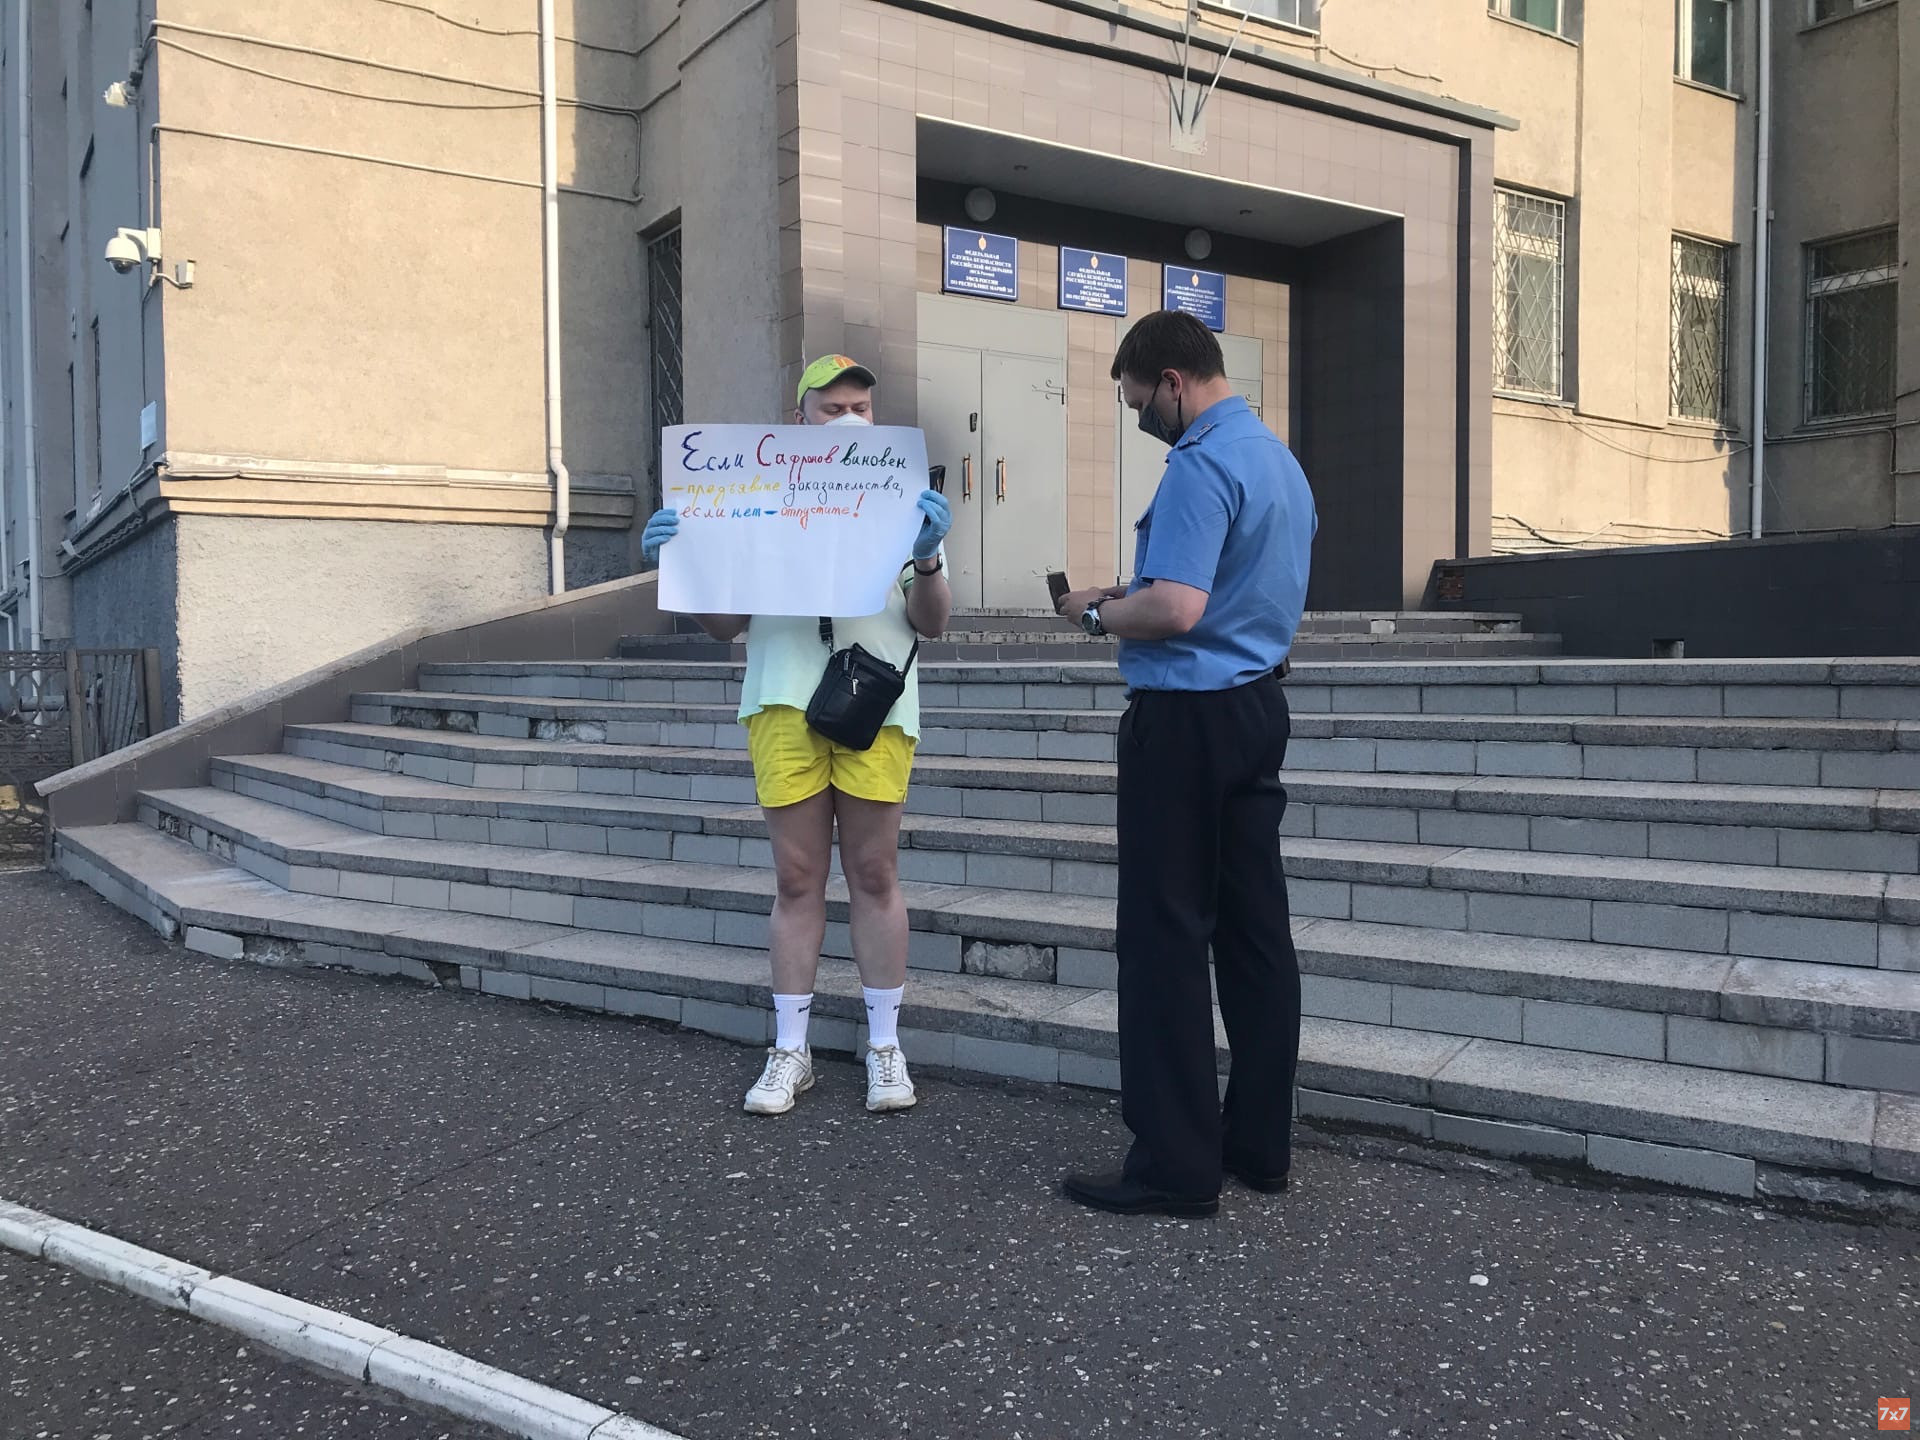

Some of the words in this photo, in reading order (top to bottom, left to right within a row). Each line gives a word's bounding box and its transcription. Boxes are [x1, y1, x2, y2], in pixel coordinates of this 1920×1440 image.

[681, 430, 744, 471] Если
[756, 433, 840, 483] Сафронов
[839, 442, 907, 469] виновен
[680, 507, 726, 519] если
